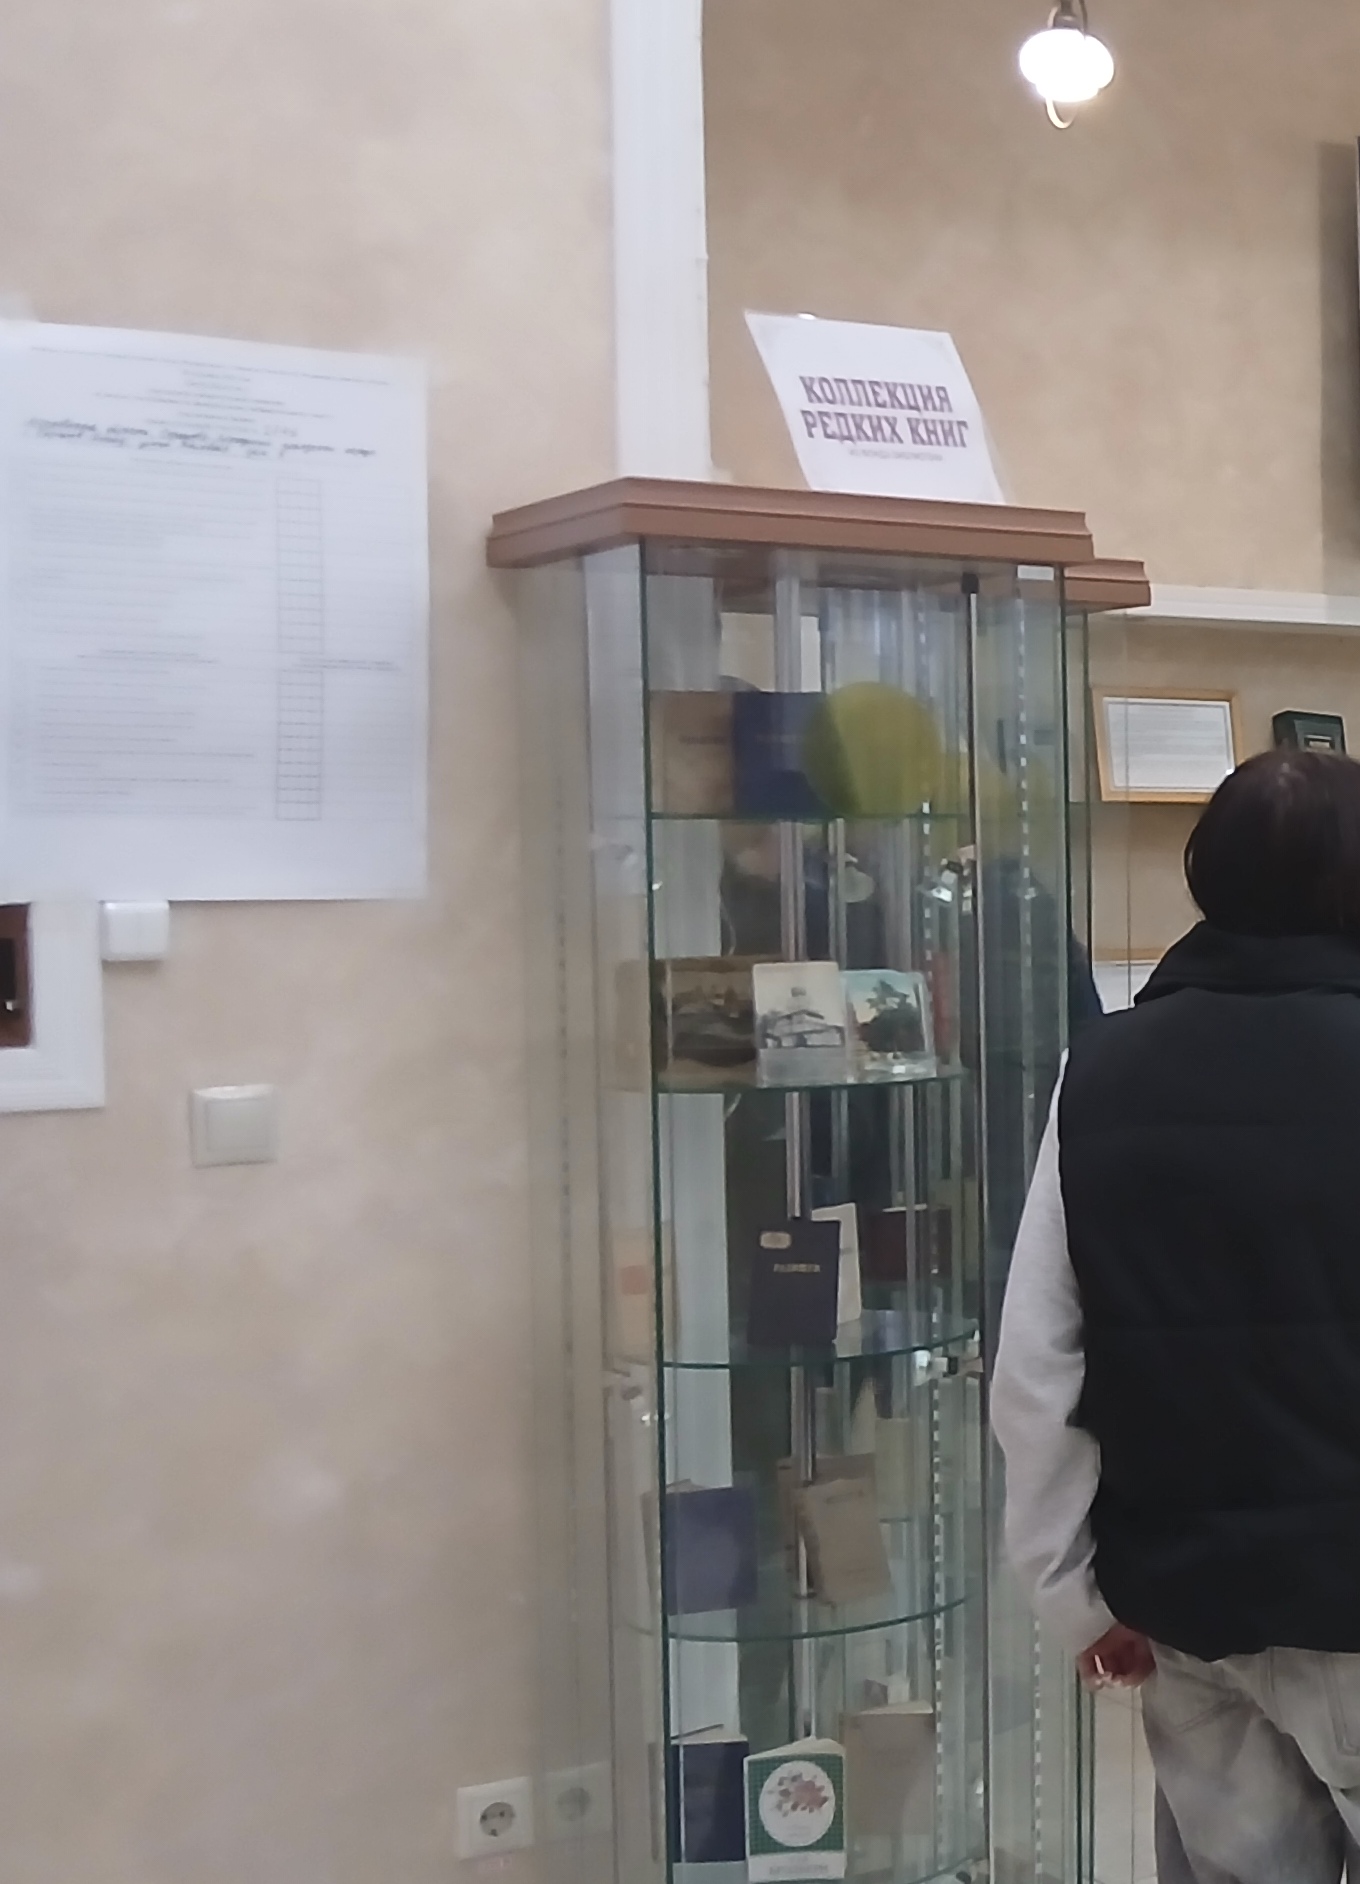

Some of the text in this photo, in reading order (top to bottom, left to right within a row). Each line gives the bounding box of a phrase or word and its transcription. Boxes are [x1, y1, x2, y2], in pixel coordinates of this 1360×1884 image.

[799, 375, 953, 414] КОЛЛЕКЦИЯ
[800, 410, 969, 448] РЕДКИХ КНИГ
